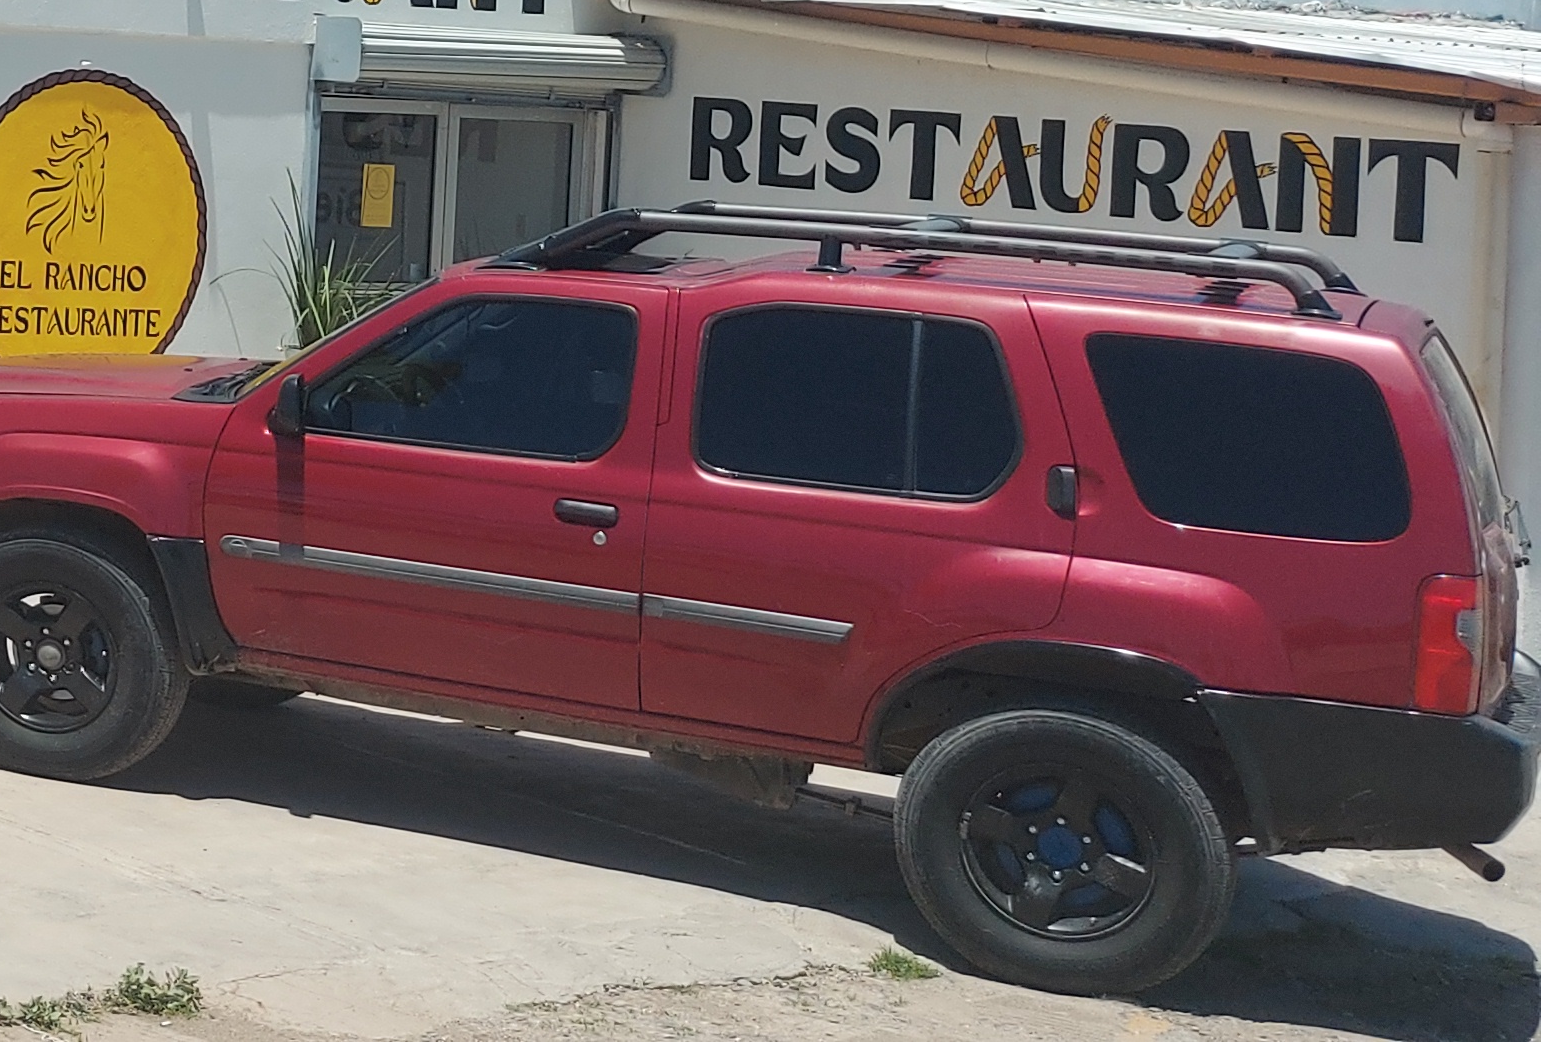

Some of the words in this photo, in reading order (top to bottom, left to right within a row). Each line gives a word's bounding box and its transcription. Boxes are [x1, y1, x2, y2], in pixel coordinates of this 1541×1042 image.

[690, 96, 1461, 244] RESTAURANT
[0, 259, 33, 290] EL
[44, 261, 147, 293] RANCHO
